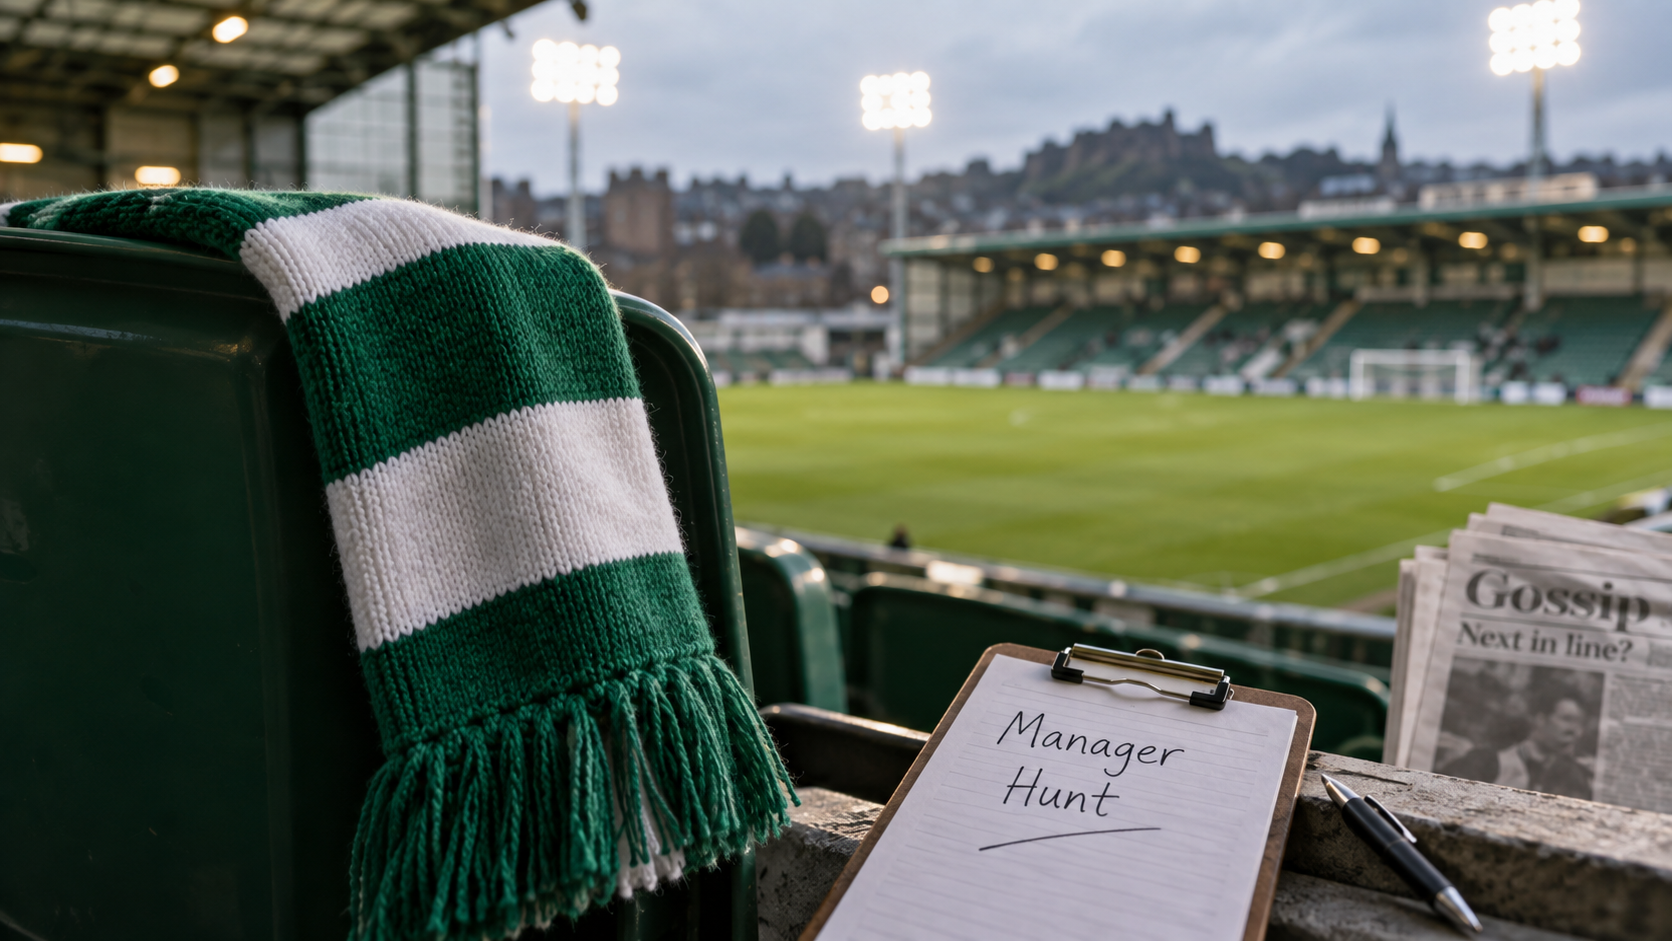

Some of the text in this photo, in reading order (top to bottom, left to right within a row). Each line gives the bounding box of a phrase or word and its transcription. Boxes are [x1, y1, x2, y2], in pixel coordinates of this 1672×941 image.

[1467, 569, 1650, 632] Gossip
[1458, 622, 1522, 650] Next
[1530, 630, 1557, 656] in
[1565, 633, 1634, 663] line?
[997, 710, 1185, 777] Manager
[1003, 766, 1120, 817] Hunt
